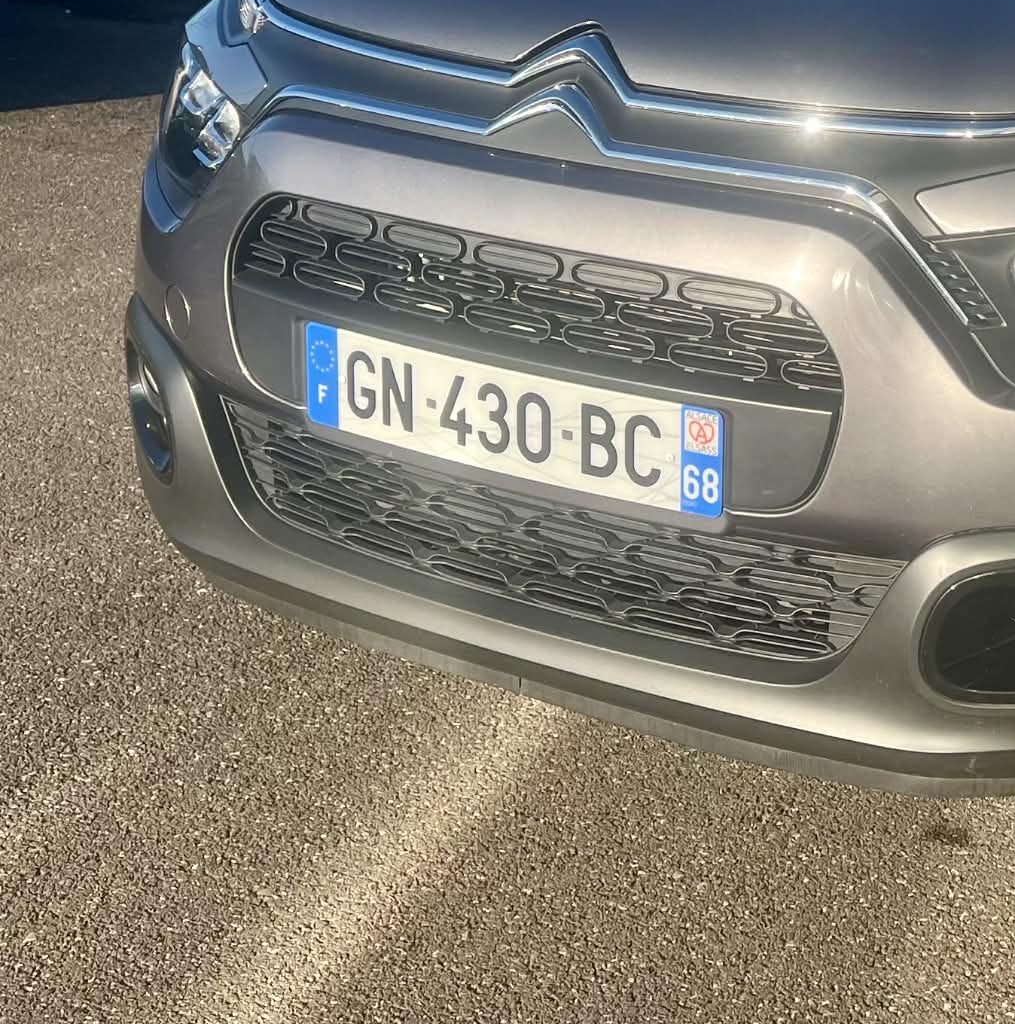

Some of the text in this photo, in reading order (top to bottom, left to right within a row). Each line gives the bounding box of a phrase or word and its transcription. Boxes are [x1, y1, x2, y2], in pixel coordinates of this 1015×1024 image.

[317, 383, 328, 404] F
[686, 410, 718, 425] ALSACE
[683, 464, 719, 504] 68
